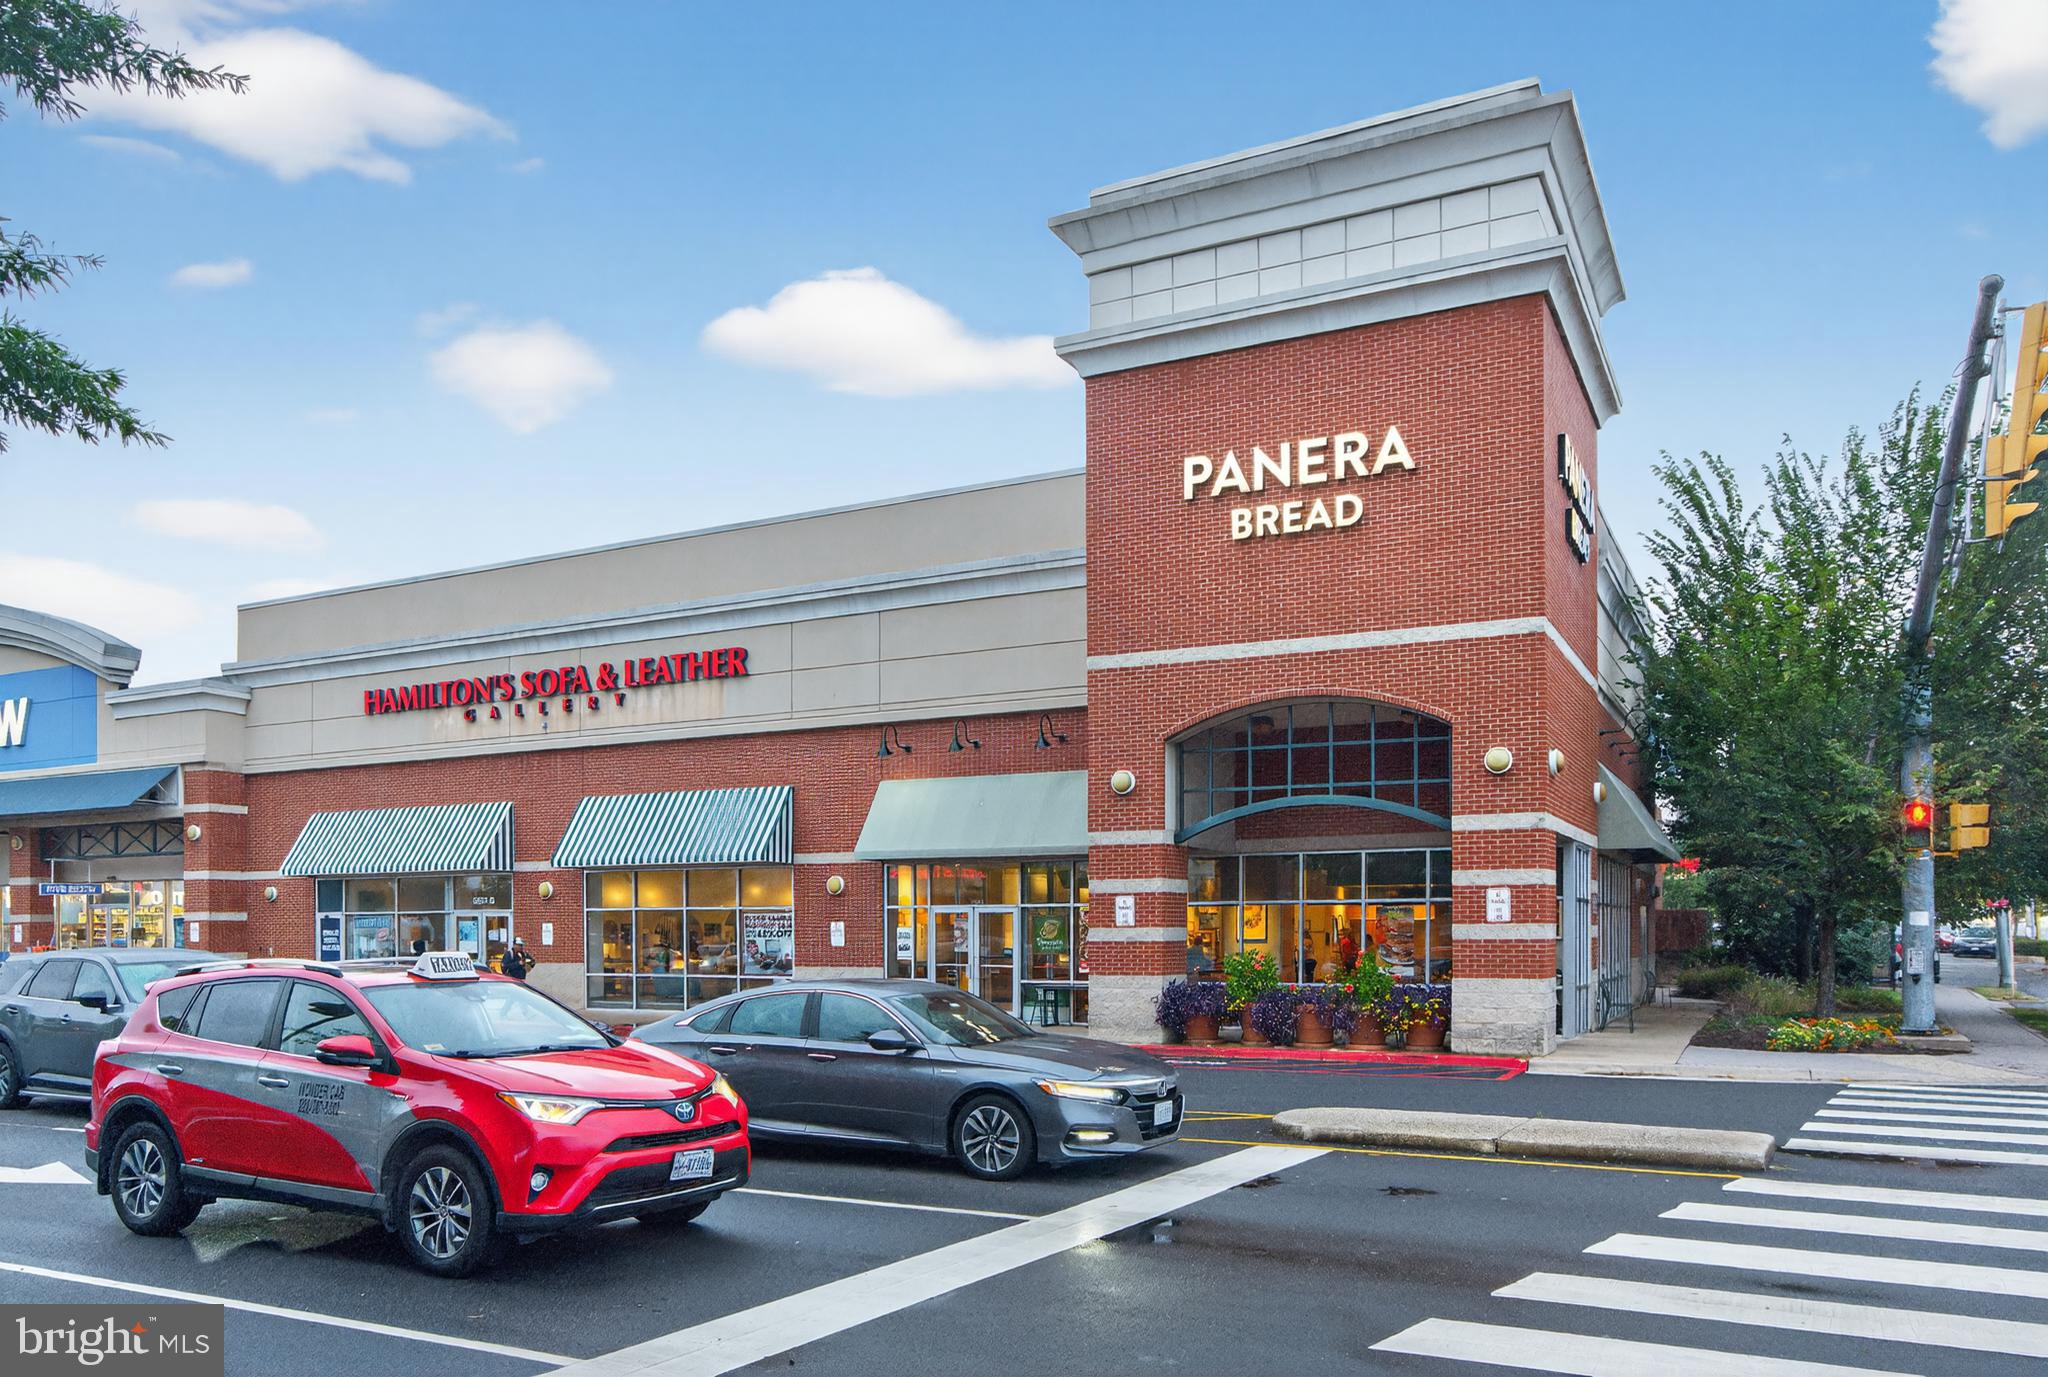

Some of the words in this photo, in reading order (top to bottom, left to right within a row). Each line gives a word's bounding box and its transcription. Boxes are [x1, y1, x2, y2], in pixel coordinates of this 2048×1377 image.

[1183, 425, 1415, 500] PANERA
[1231, 494, 1364, 540] BREAD
[364, 673, 514, 715] HAMILTON'S
[520, 665, 591, 698] SOFA
[596, 662, 619, 689] &
[624, 647, 748, 687] LEATHER
[463, 693, 627, 722] GALLERY
